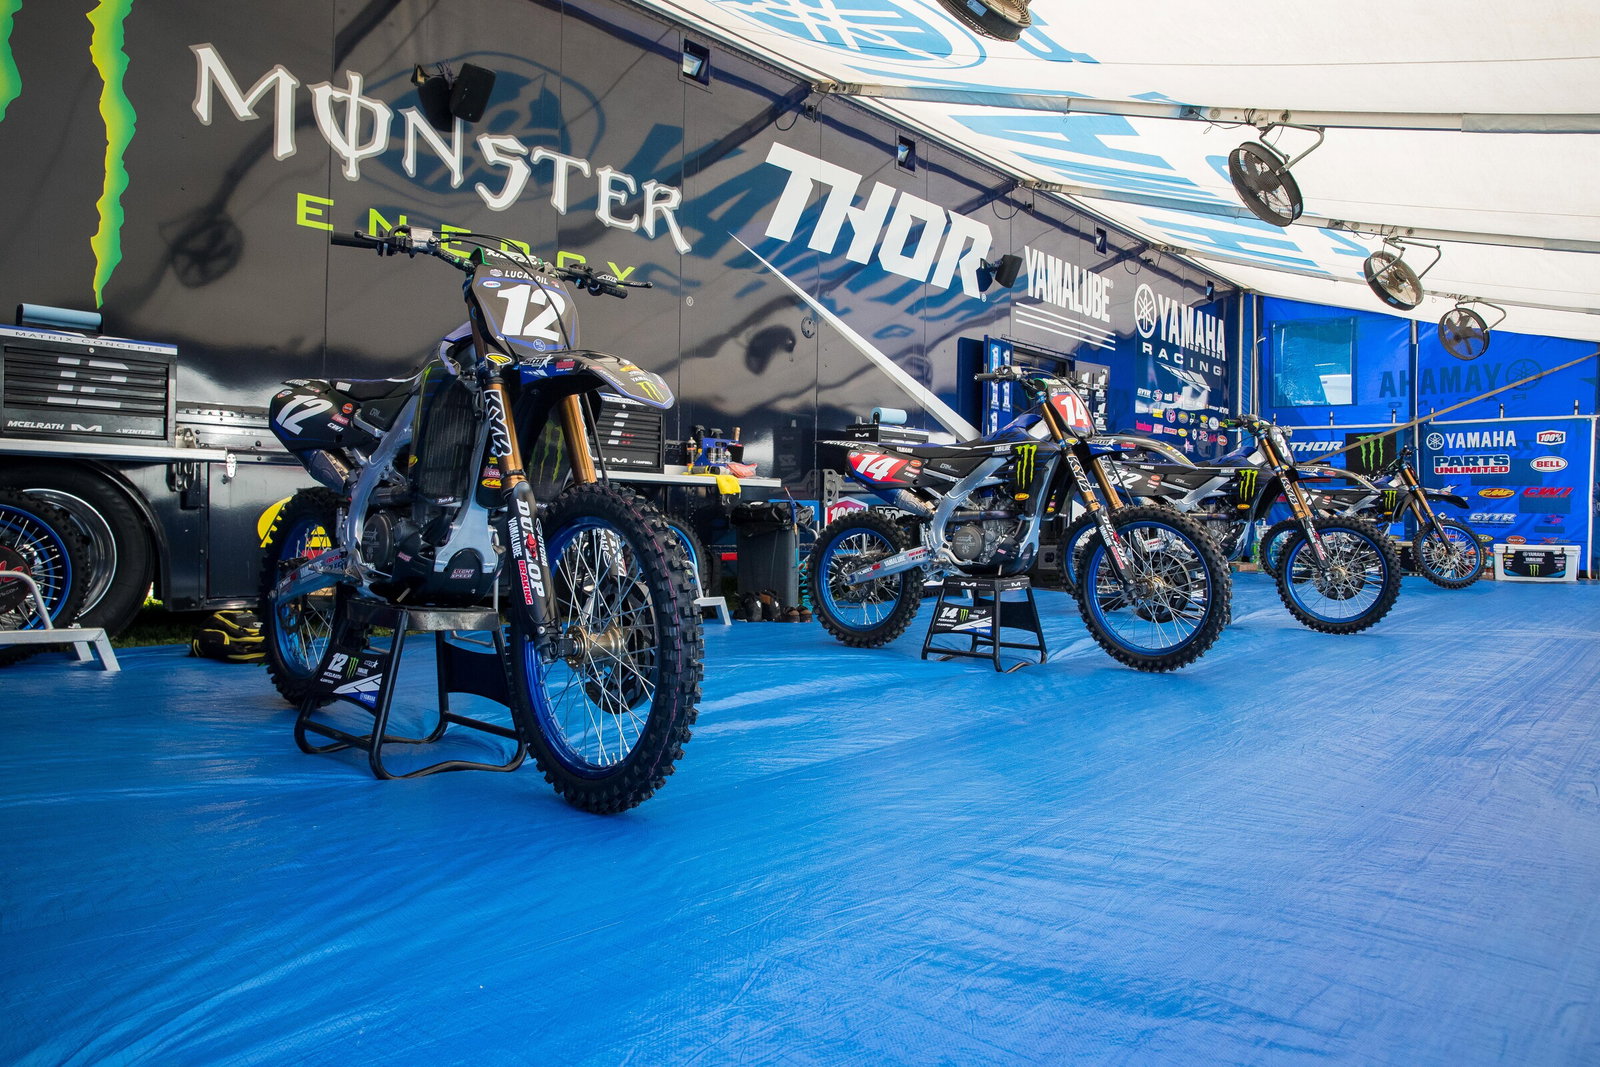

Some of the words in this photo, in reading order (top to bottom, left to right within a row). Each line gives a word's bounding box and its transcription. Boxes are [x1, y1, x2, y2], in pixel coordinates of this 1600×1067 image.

[189, 43, 691, 254] MONSTER
[765, 142, 993, 299] THOR
[1023, 245, 1111, 323] YAMALUBE
[496, 284, 566, 342] 12
[1158, 294, 1226, 361] YAMAHA
[15, 331, 73, 343] MATRIX
[81, 339, 163, 353] CONCEPTS
[1142, 343, 1223, 376] RACING
[7, 420, 65, 431] MCELRATH
[275, 394, 334, 436] 12
[1060, 396, 1089, 426] 14
[1290, 441, 1344, 451] THOR
[1445, 430, 1517, 449] YAMAHA
[1540, 433, 1562, 442] 100%
[855, 453, 900, 481] 14
[1434, 455, 1509, 467] PARTS
[1434, 465, 1509, 474] UNLIMITED
[1536, 459, 1562, 468] BELL
[1522, 486, 1574, 497] CWI
[1468, 512, 1517, 523] GYTR
[507, 516, 523, 559] YAMALUBE
[516, 498, 546, 598] DULOP
[1101, 515, 1129, 565] DULOP
[517, 560, 534, 606] BRAKING
[940, 606, 959, 619] 14
[328, 652, 349, 673] 12
